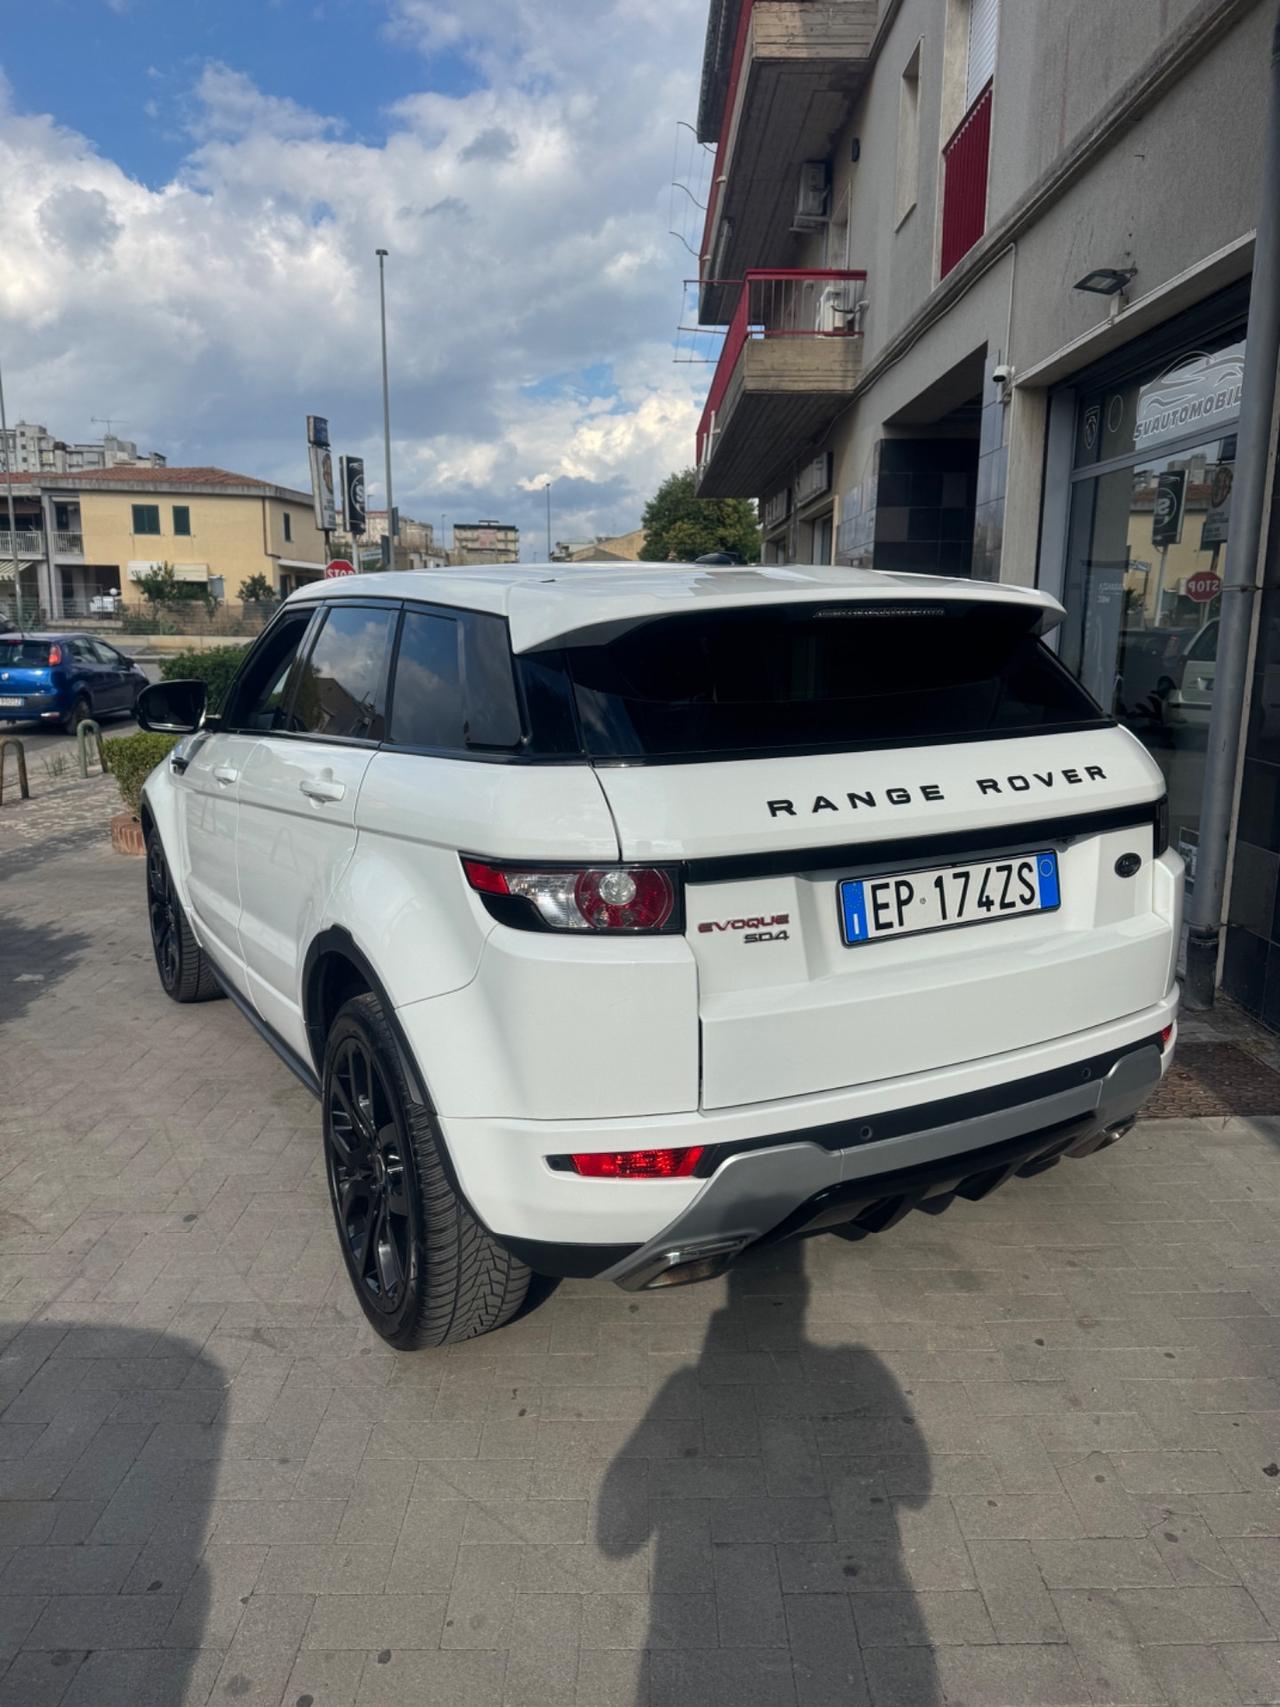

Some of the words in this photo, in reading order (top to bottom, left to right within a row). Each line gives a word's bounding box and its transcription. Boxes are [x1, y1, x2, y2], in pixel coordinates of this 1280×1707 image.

[767, 784, 945, 818] RANGE
[976, 765, 1107, 796] ROVER
[698, 914, 790, 933] EVOQUE
[744, 930, 790, 944] SD4
